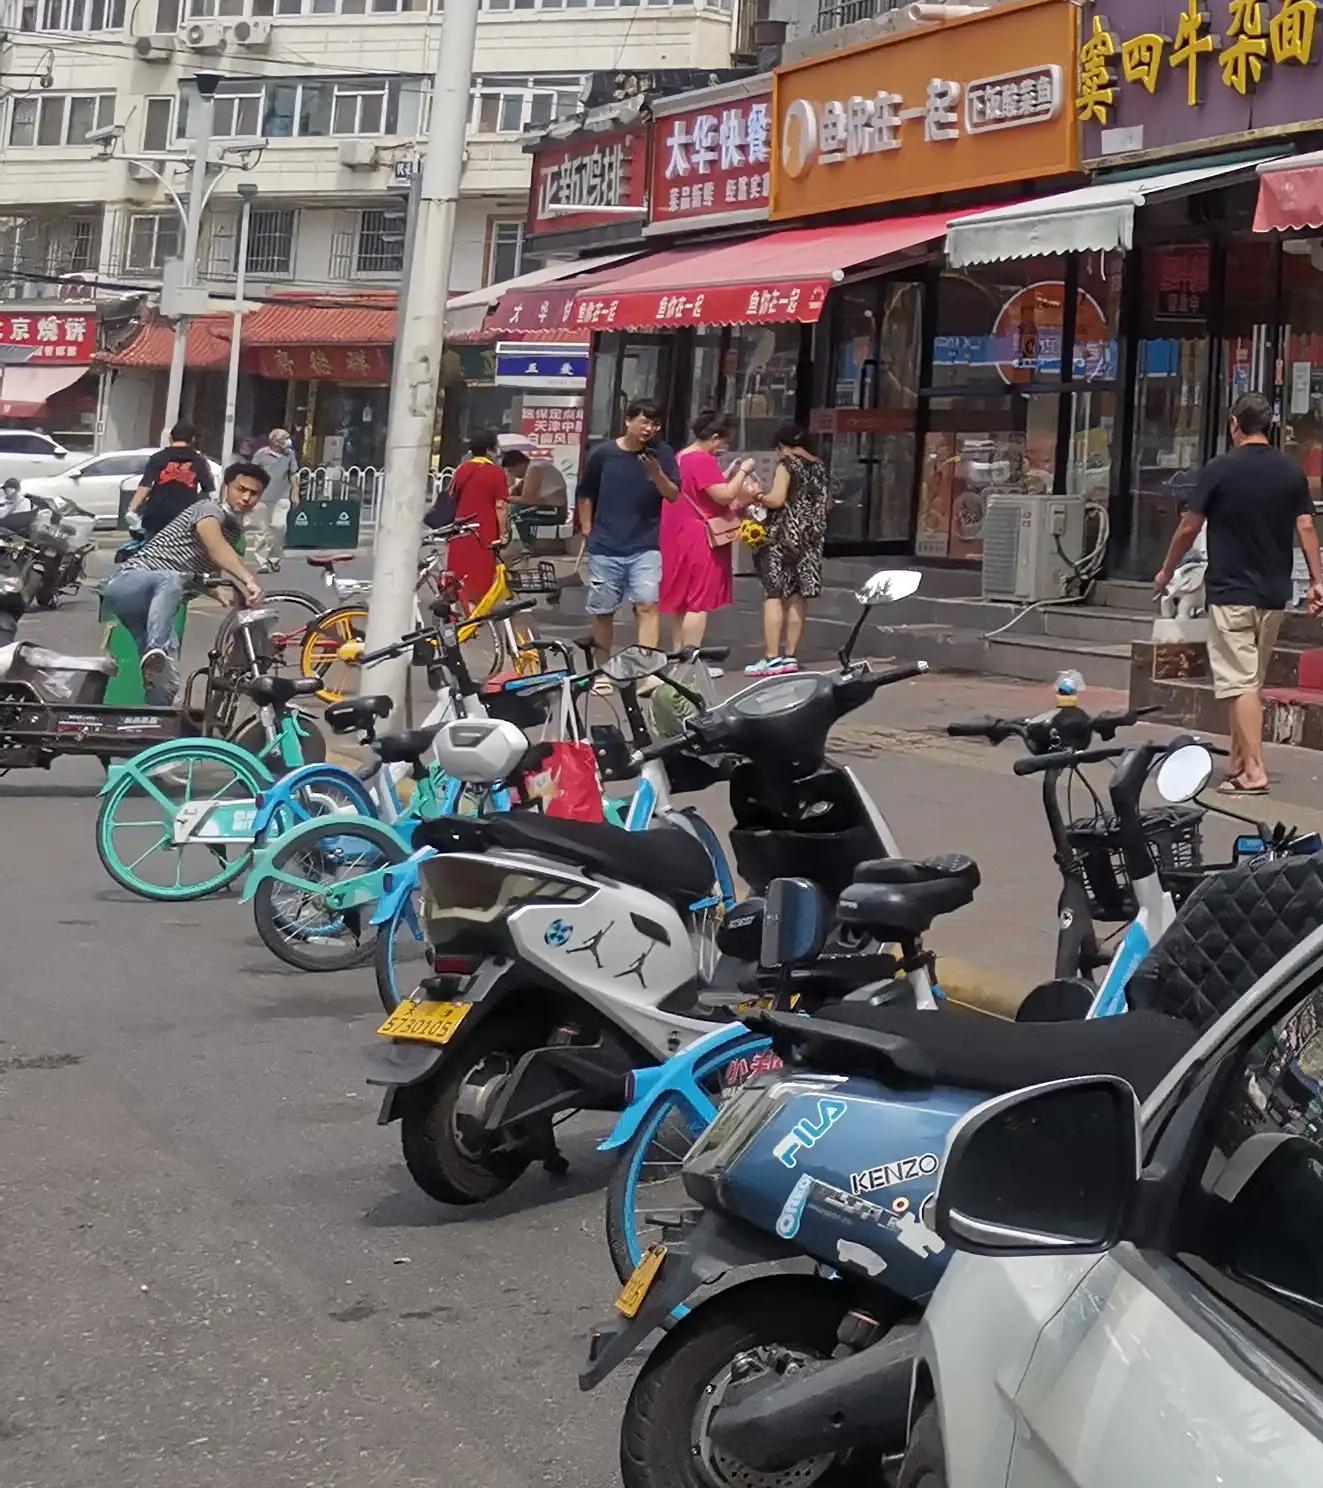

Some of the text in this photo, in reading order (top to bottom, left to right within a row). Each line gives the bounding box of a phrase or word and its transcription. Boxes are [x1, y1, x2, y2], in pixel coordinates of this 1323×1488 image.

[0, 315, 87, 343] 京烧饼
[850, 1153, 940, 1195] KENZO
